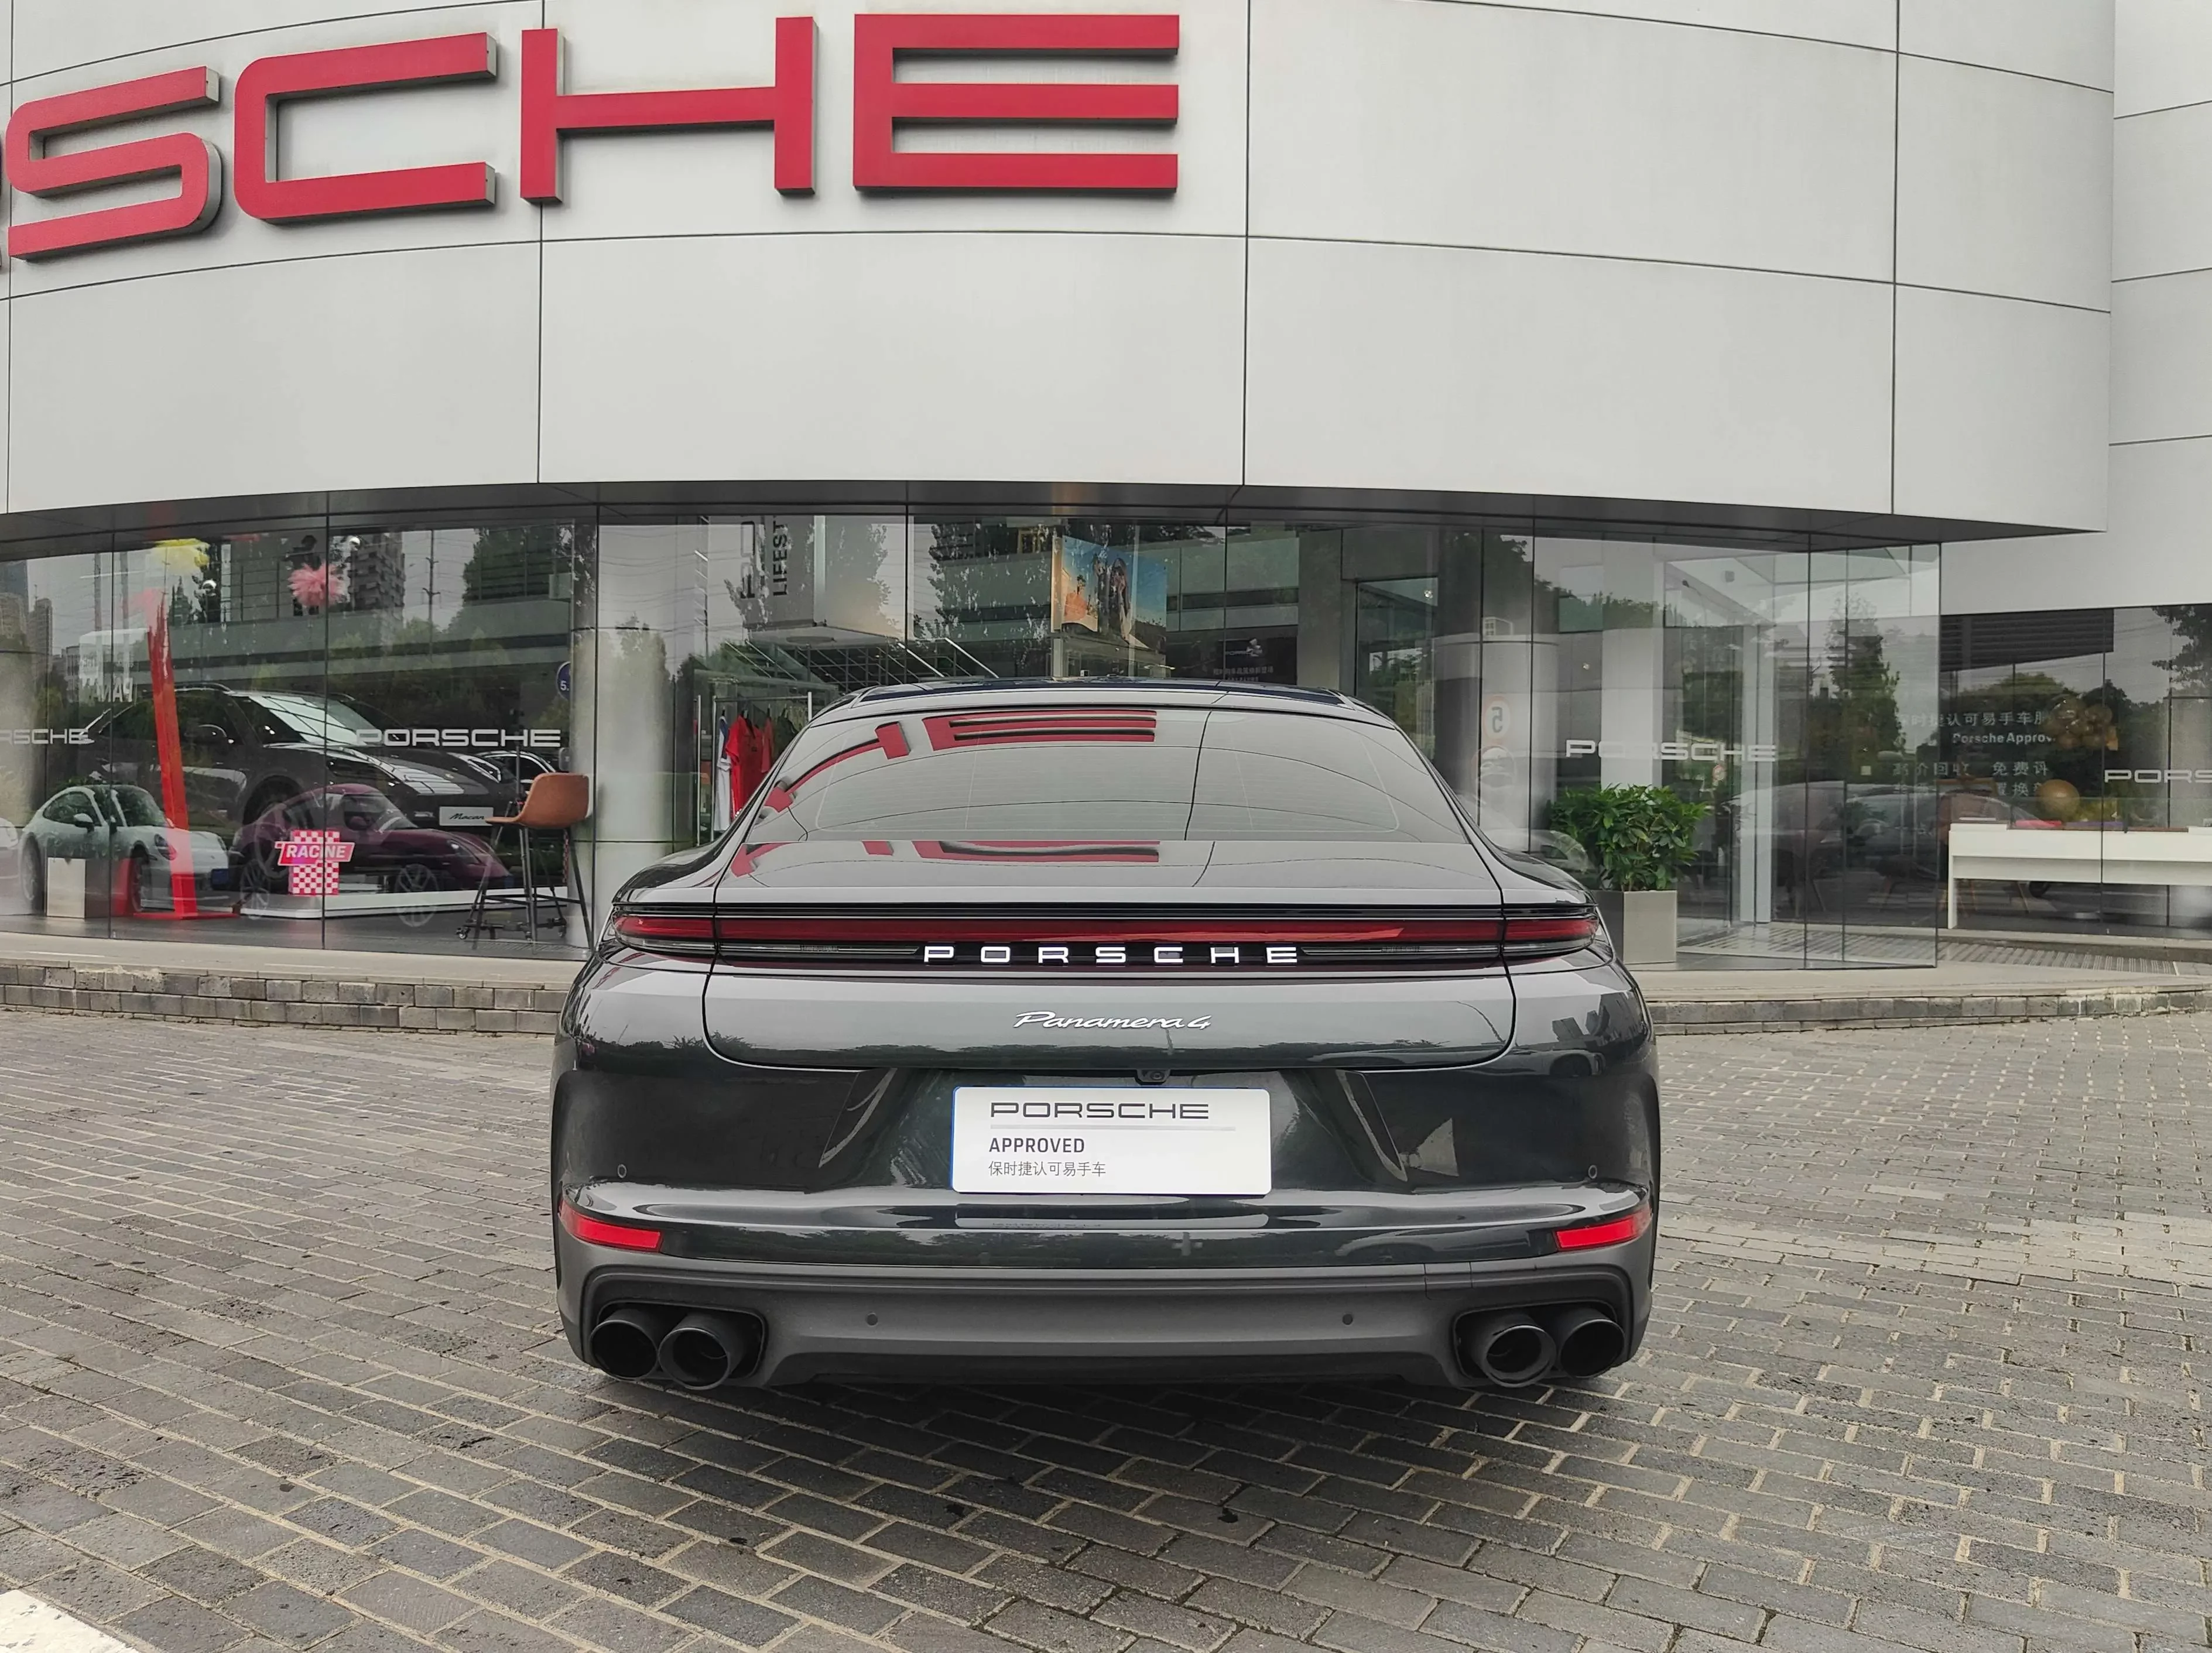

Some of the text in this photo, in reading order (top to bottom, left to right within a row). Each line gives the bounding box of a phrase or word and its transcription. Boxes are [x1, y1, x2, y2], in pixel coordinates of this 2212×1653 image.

[773, 515, 788, 596] LIFEST
[355, 729, 561, 747] PORSCHE
[1953, 732, 2004, 743] Porsche
[1566, 739, 1776, 762] PORSCHE
[449, 812, 485, 821] Macan
[923, 946, 1297, 964] PORSCHE
[1013, 1011, 1184, 1030] Panamera
[990, 1102, 1209, 1119] PORSCHE
[989, 1137, 1086, 1153] APPROVED
[988, 1161, 1107, 1177] 保时捷认可易手车
